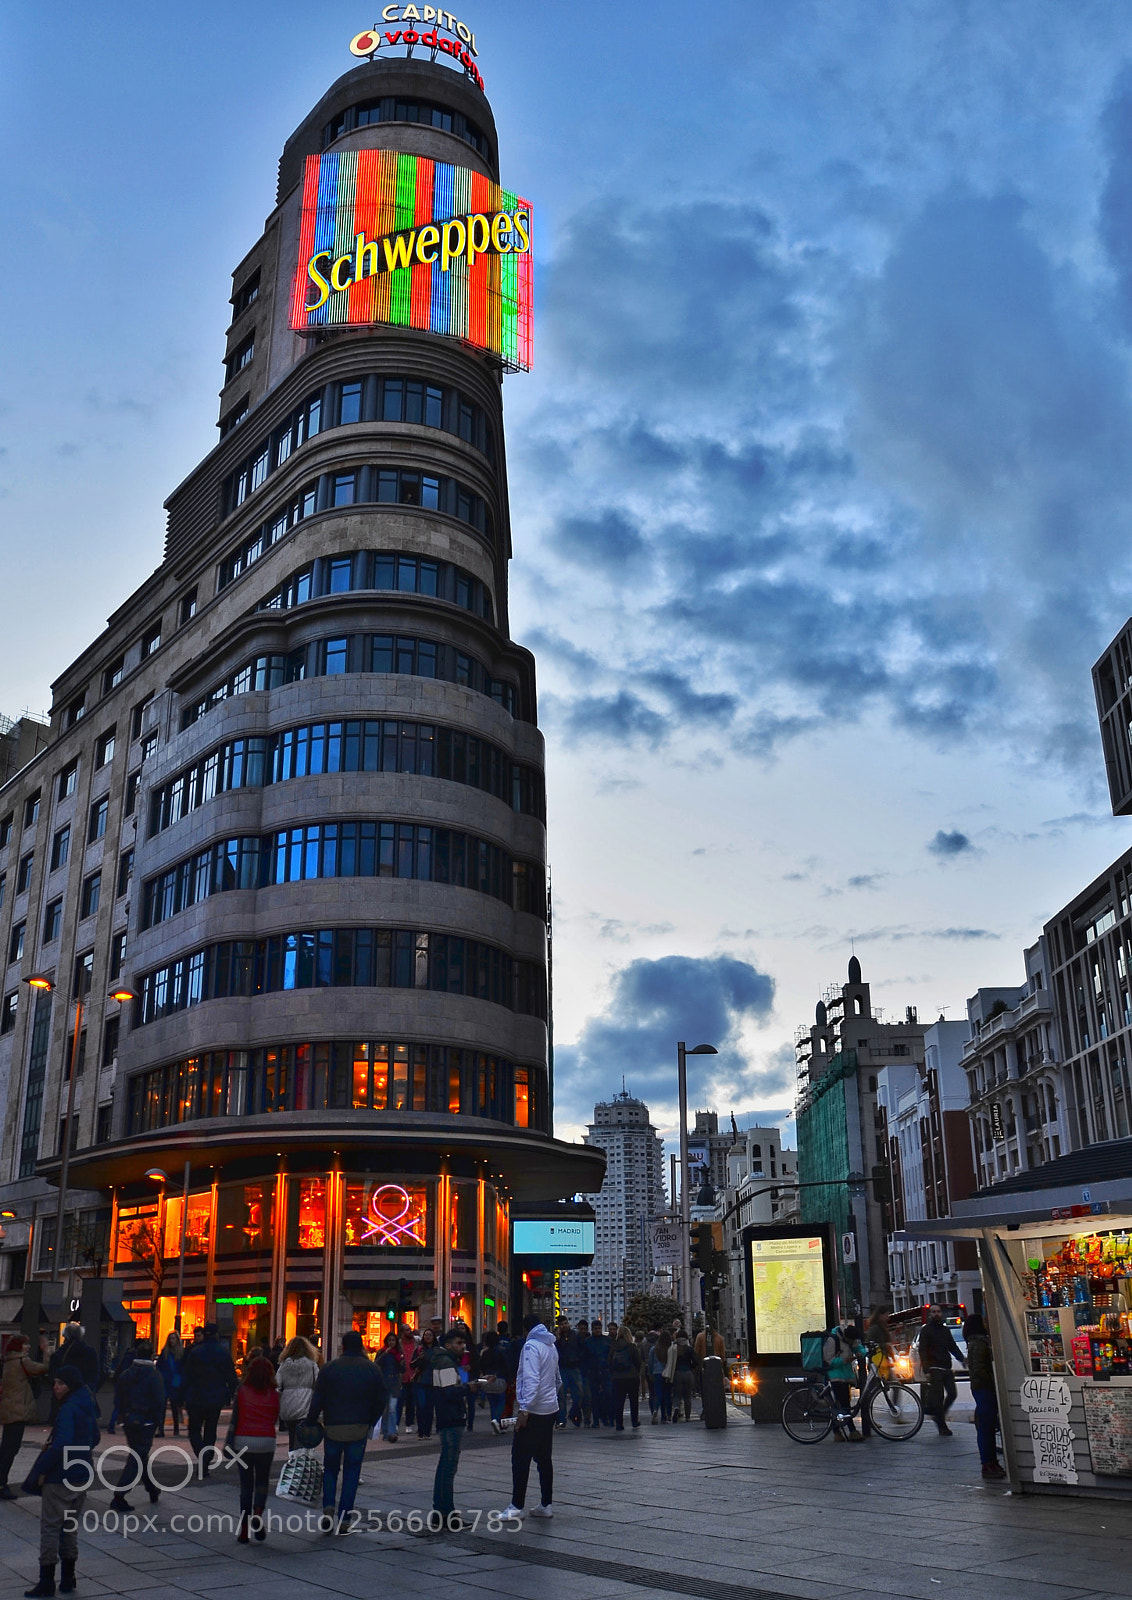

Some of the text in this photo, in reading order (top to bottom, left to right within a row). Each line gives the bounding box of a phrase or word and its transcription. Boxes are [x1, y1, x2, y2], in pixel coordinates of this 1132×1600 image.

[382, 3, 479, 57] CAPITOL
[304, 209, 530, 312] Schweppes
[654, 1227, 669, 1236] SAN
